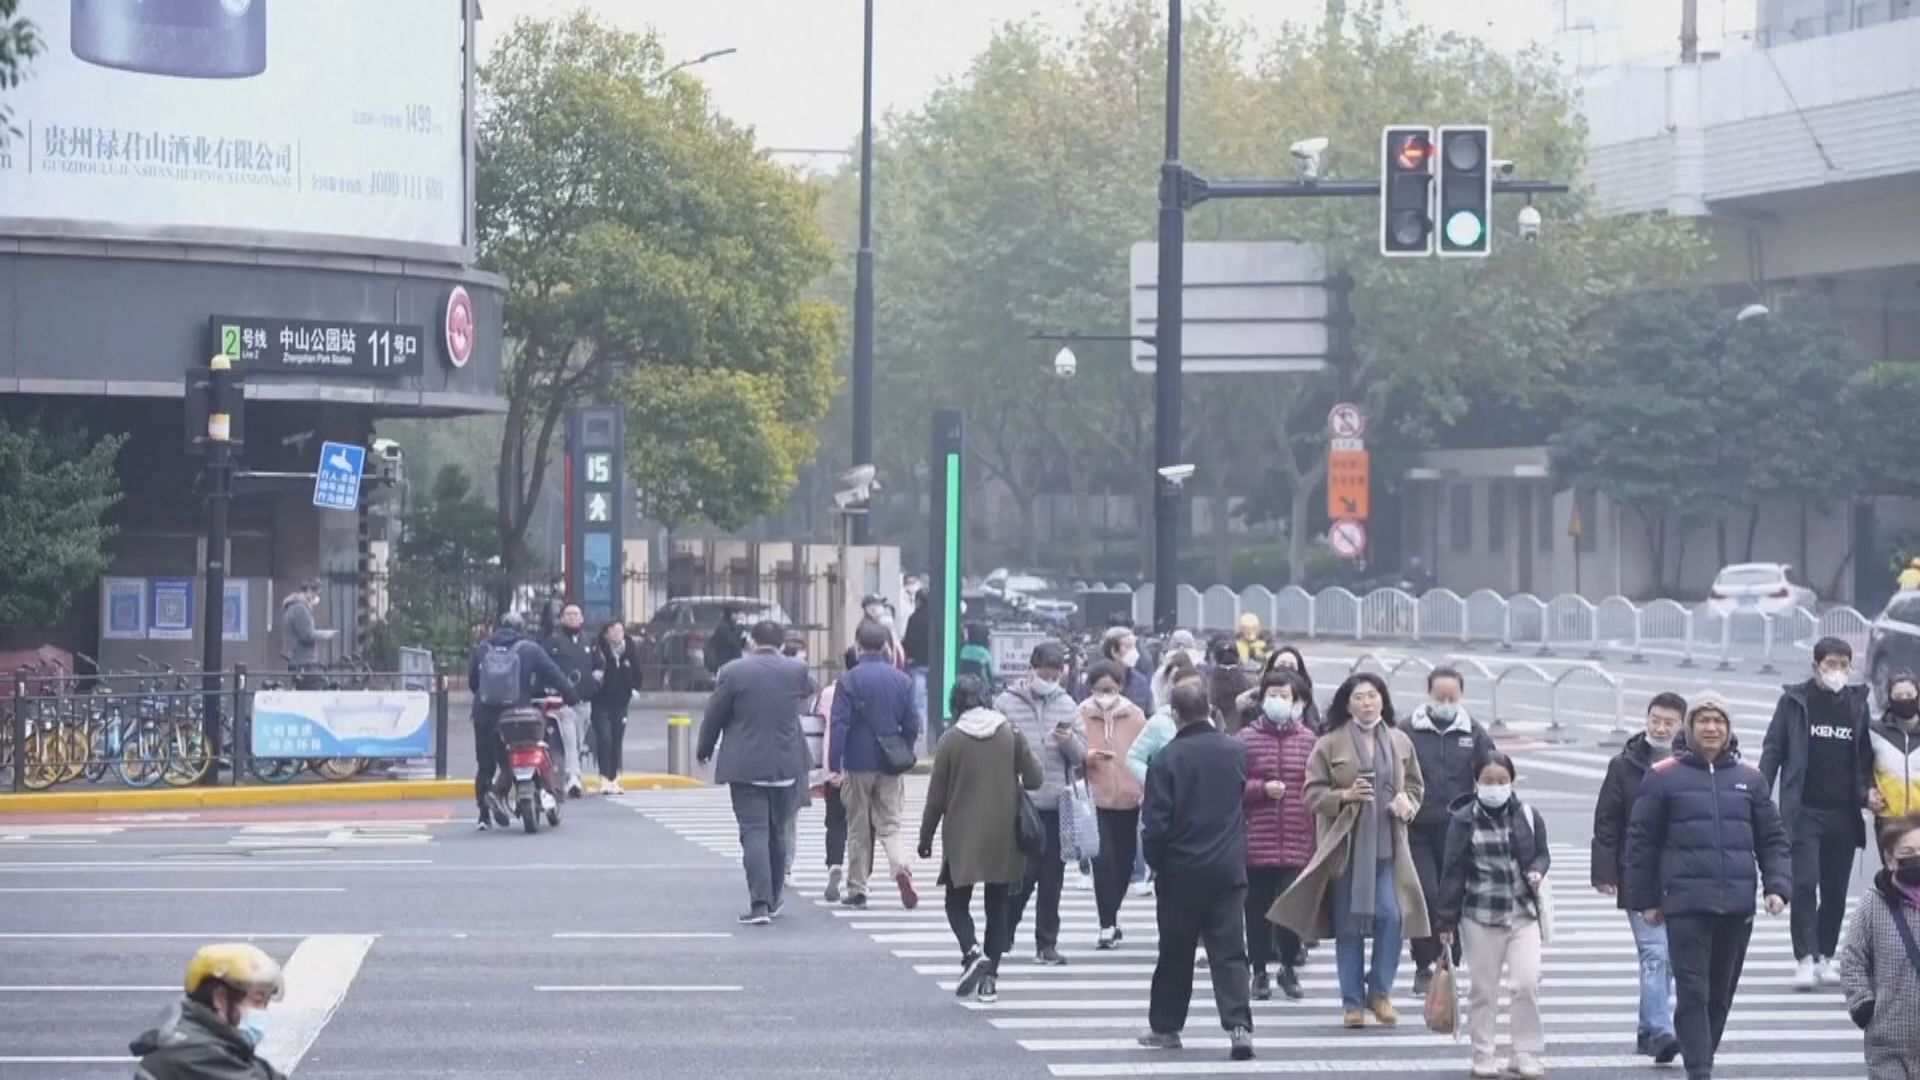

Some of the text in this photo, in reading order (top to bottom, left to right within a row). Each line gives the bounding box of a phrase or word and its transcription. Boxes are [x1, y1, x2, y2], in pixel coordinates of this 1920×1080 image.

[45, 124, 292, 173] 贵州禄君山酒业有限公司
[225, 325, 416, 367] 2 号线 中山公园站 11 号口
[587, 456, 608, 482] 15
